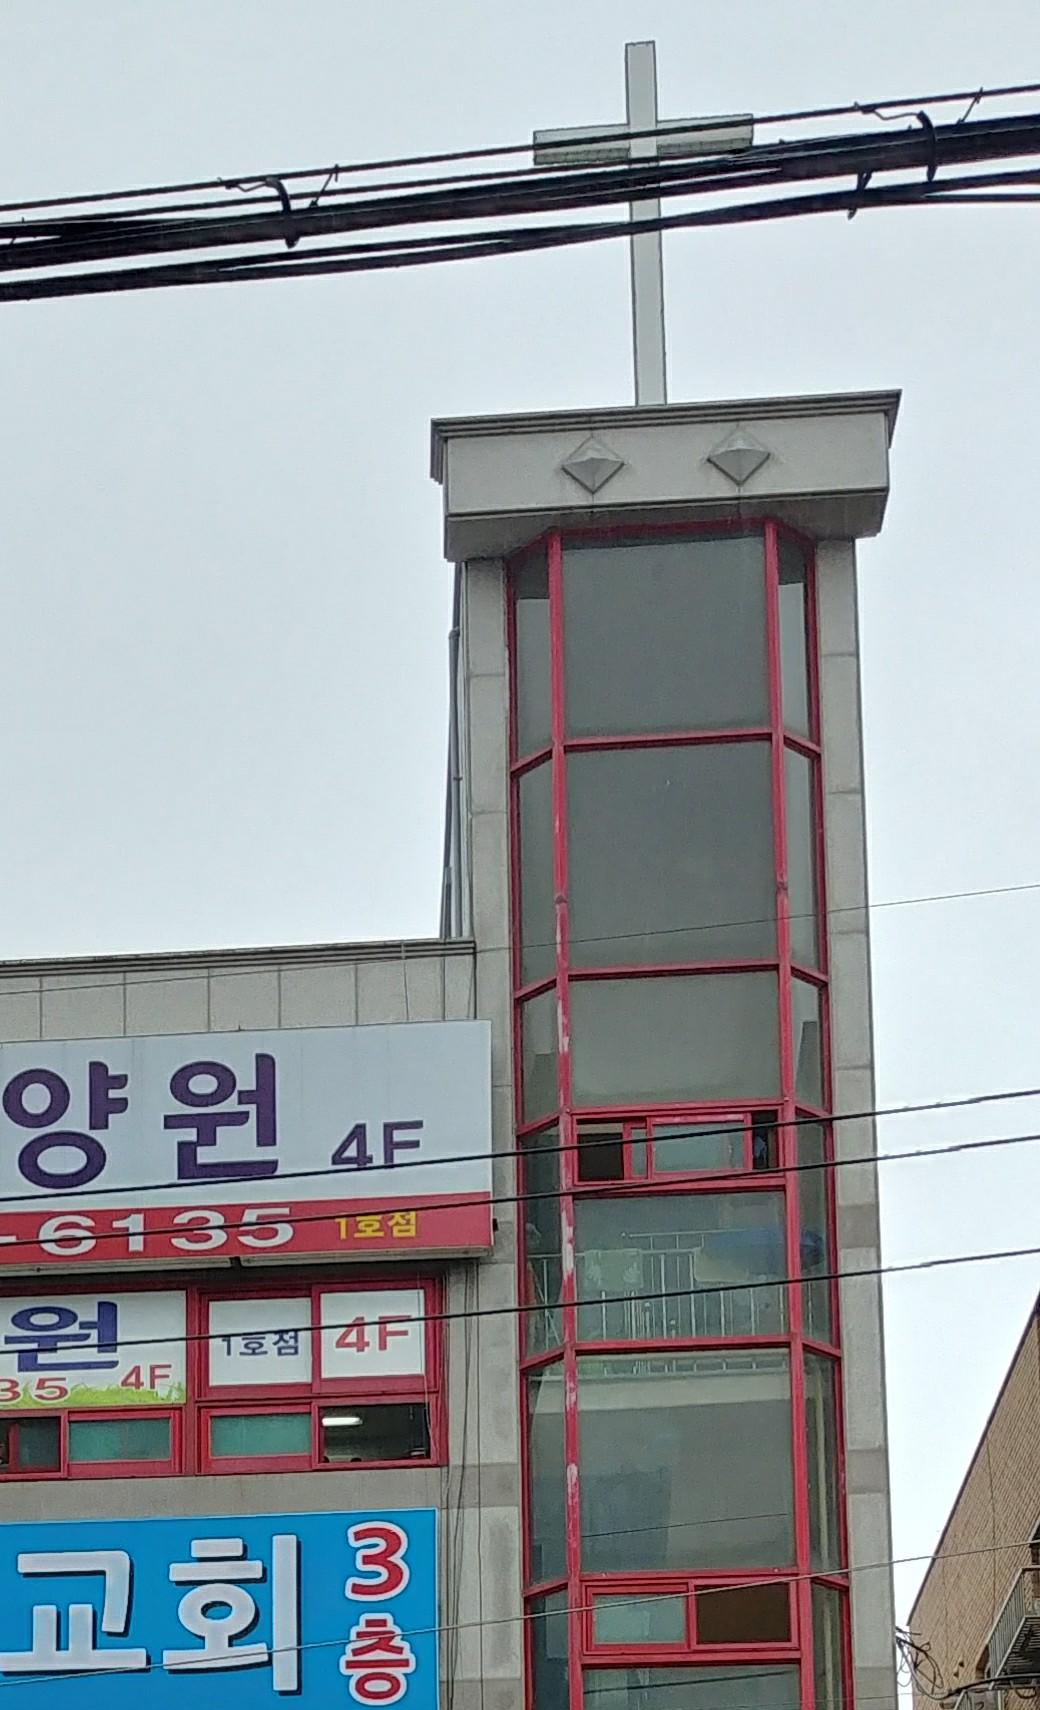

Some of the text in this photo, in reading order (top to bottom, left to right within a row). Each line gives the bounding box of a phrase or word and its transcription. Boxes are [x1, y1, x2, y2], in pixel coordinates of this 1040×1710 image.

[331, 1120, 424, 1169] 4F
[335, 1210, 418, 1241] 1호점
[221, 1313, 413, 1358] 1호점 4F
[121, 1362, 173, 1392] 4F
[339, 1521, 416, 1706] 3층
